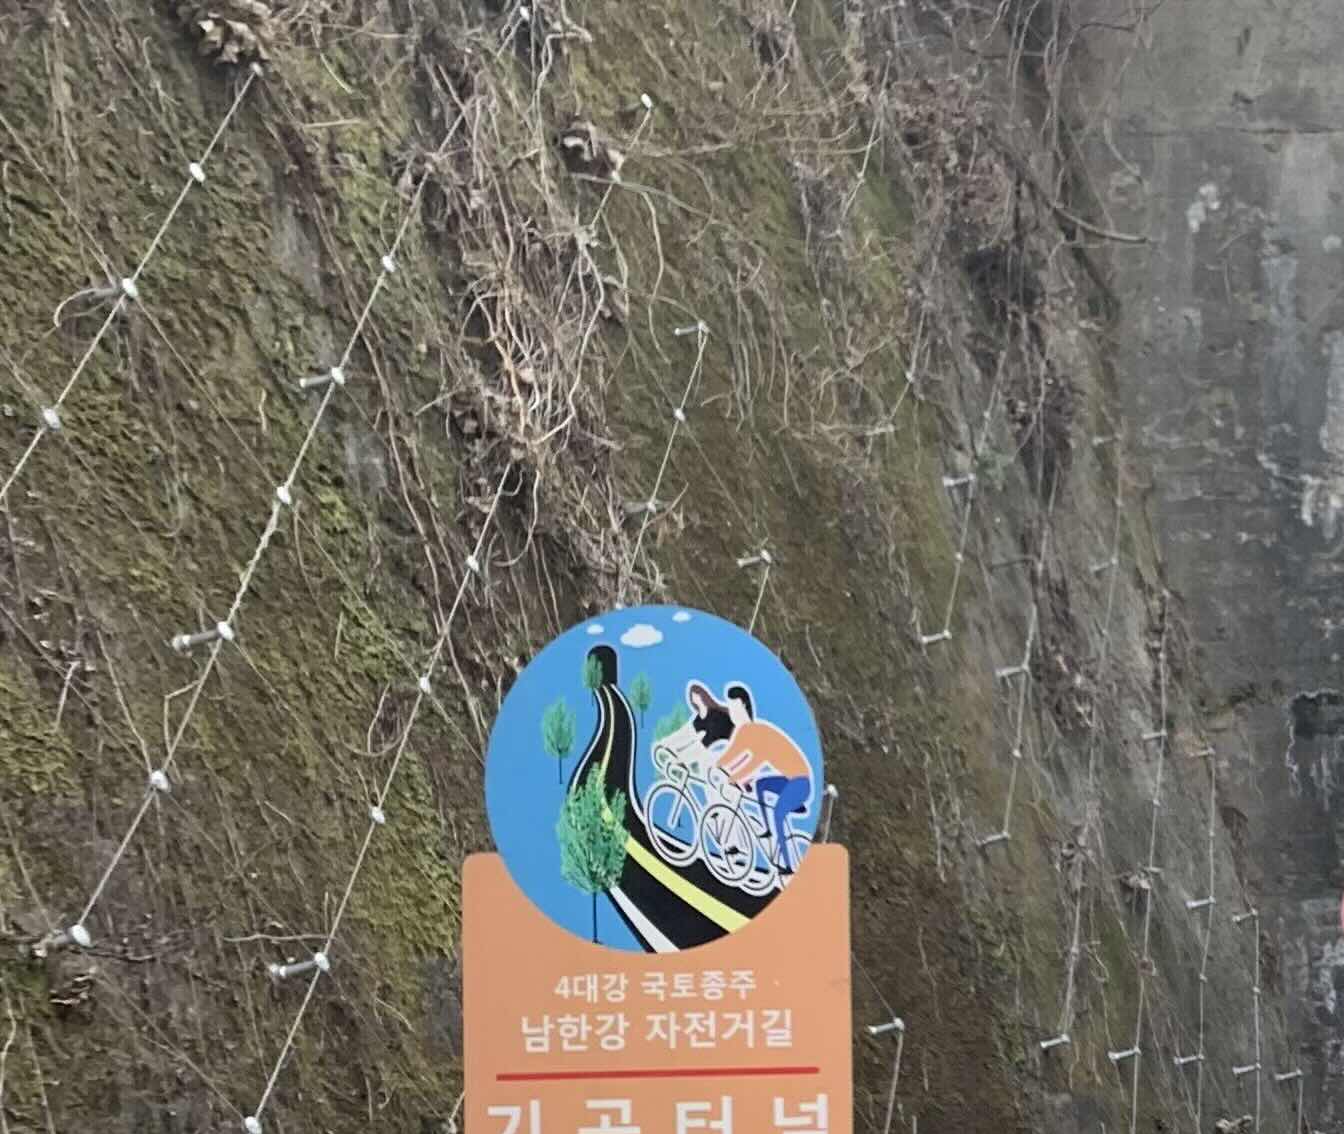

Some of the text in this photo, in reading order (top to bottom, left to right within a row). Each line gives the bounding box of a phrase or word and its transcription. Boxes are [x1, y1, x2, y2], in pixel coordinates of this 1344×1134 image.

[554, 969, 757, 1003] 4대강 국토종주
[520, 1008, 793, 1053] 남한강 자전거길
